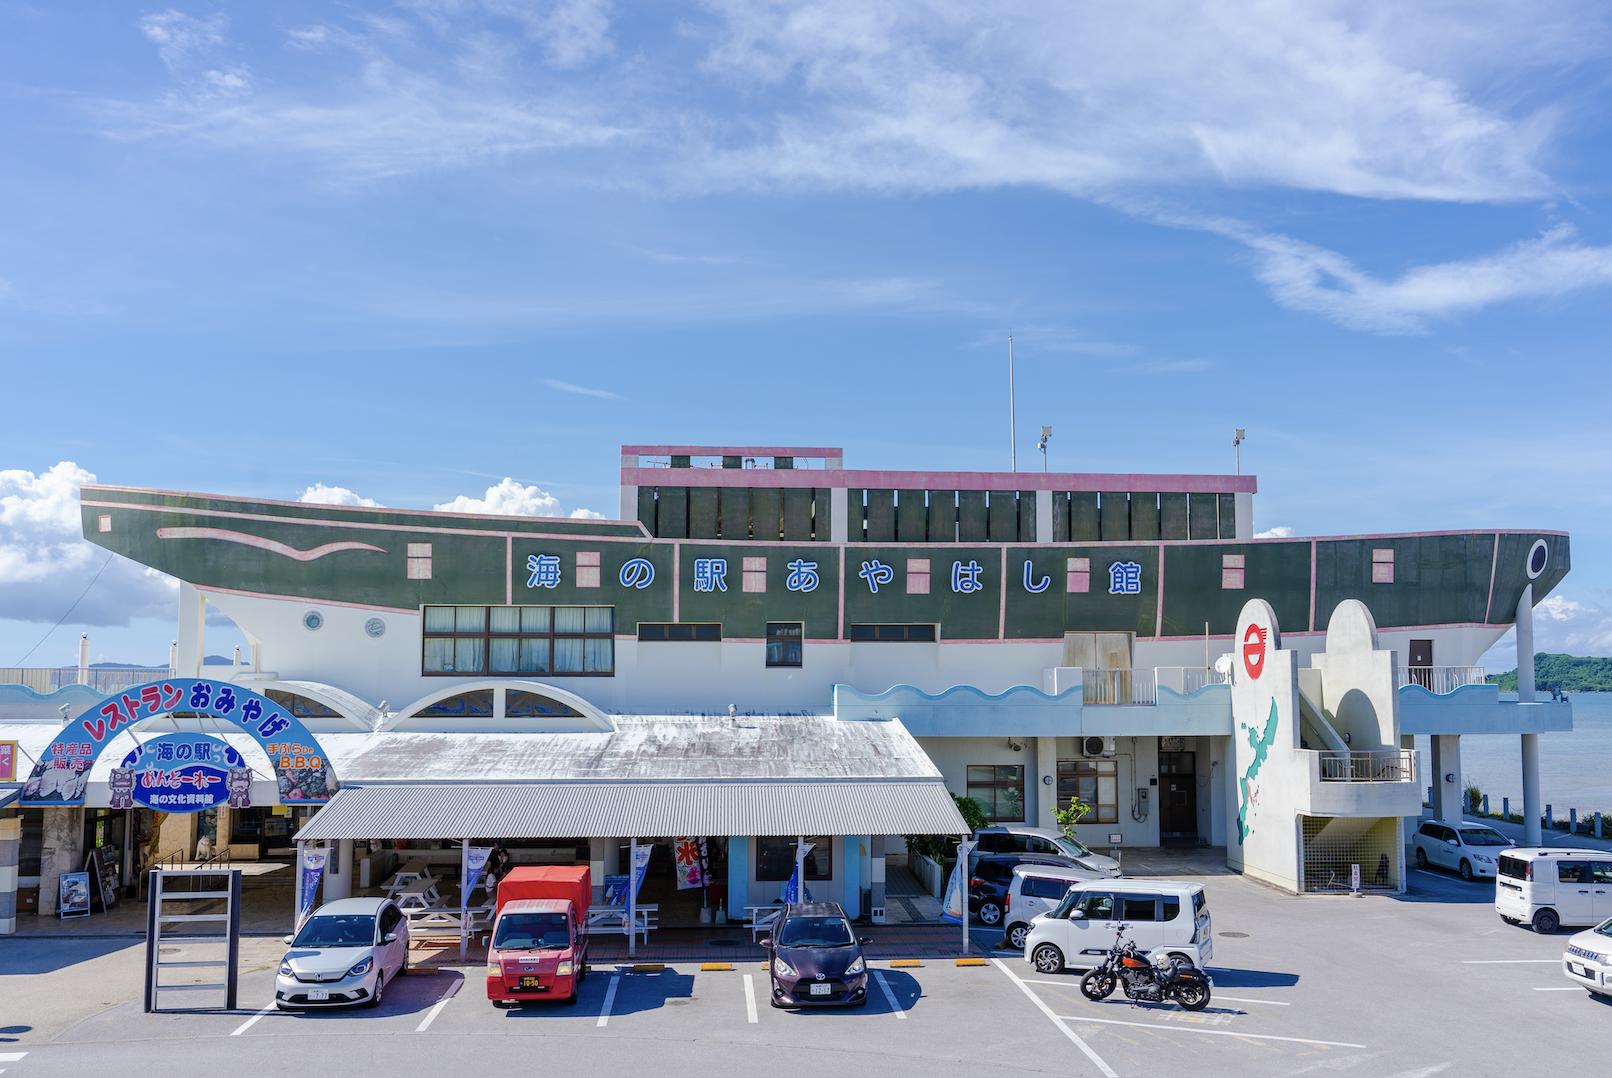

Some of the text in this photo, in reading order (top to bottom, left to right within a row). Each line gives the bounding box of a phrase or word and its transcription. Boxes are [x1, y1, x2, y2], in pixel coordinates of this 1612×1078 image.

[526, 555, 1141, 595] 海の駅あやはし館
[83, 683, 290, 742] レストラン おみやげ
[51, 743, 93, 756] 特産品
[156, 742, 212, 761] 海の駅
[53, 756, 85, 770] 販売
[279, 756, 321, 770] B.B.Q
[141, 769, 222, 789] めんそーれー
[149, 794, 214, 805] 海の文化資料館
[676, 837, 699, 866] 氷
